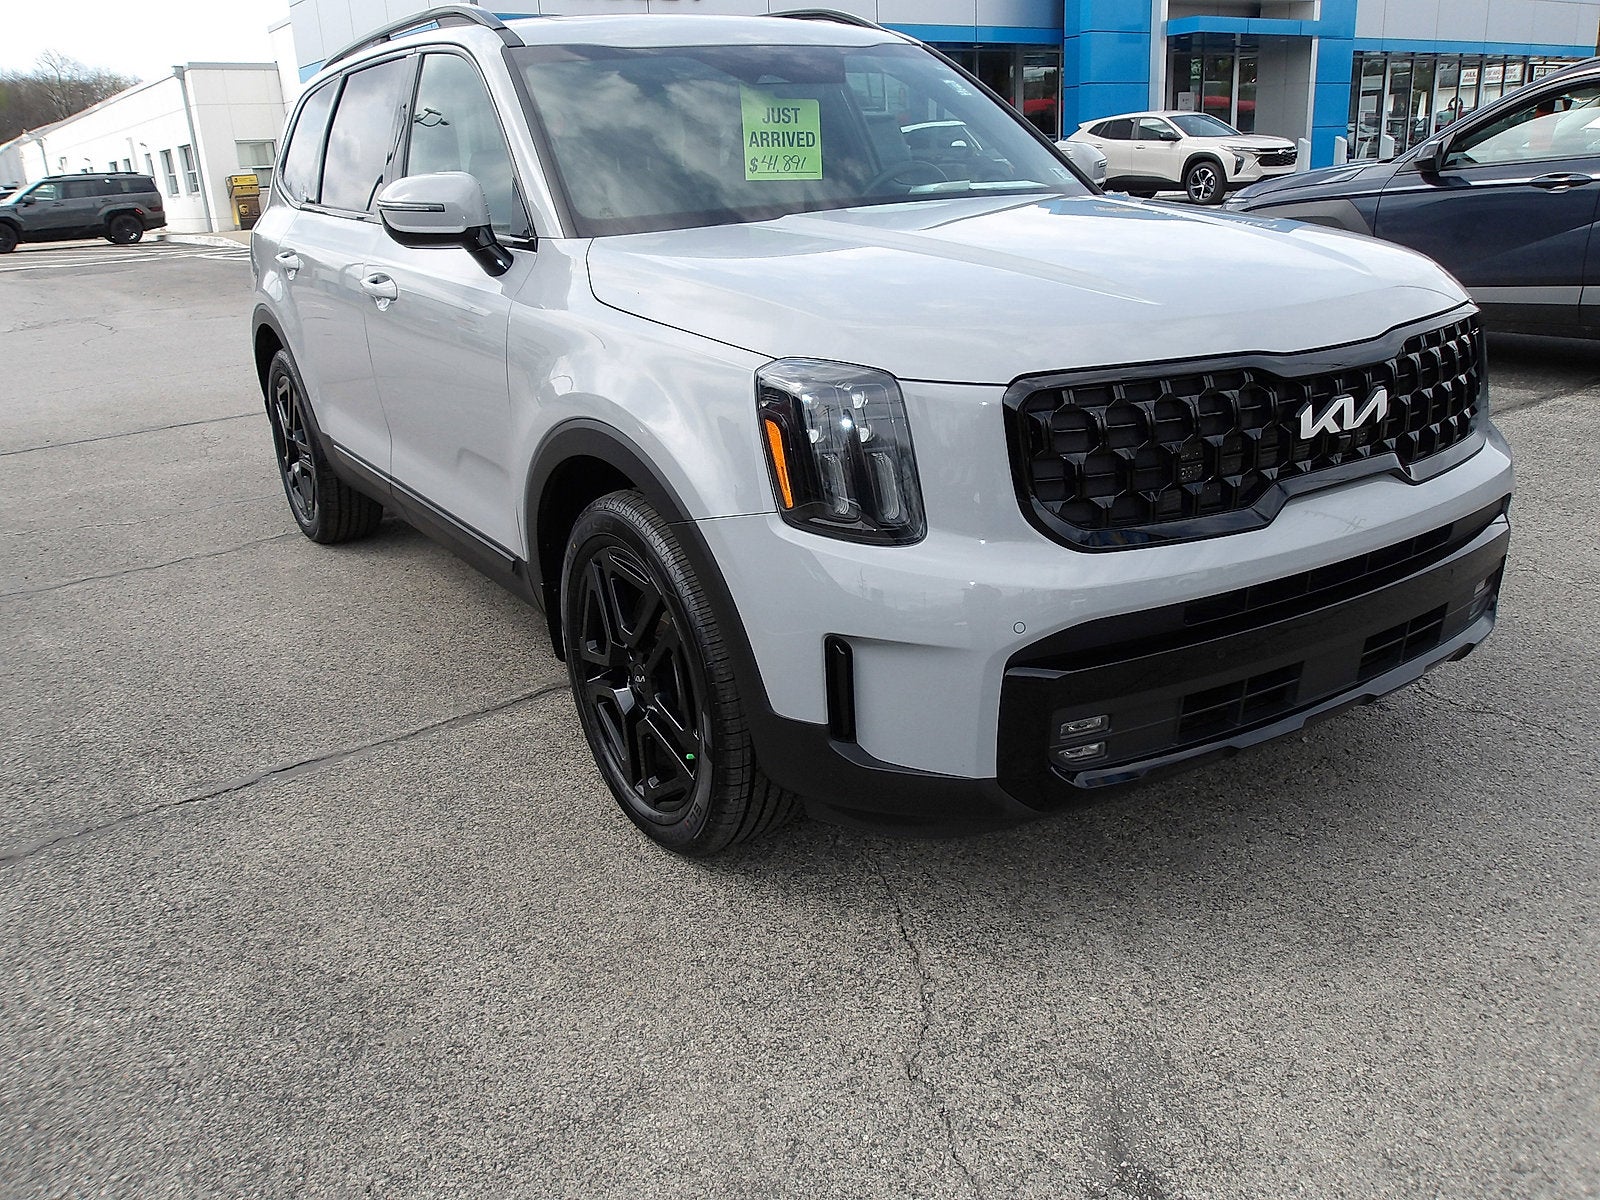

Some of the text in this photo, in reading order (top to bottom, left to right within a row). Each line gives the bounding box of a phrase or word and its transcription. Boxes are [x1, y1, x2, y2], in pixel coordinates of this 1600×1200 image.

[762, 107, 801, 124] JUST
[749, 131, 816, 148] ARRIVED
[1299, 386, 1388, 440] KIA
